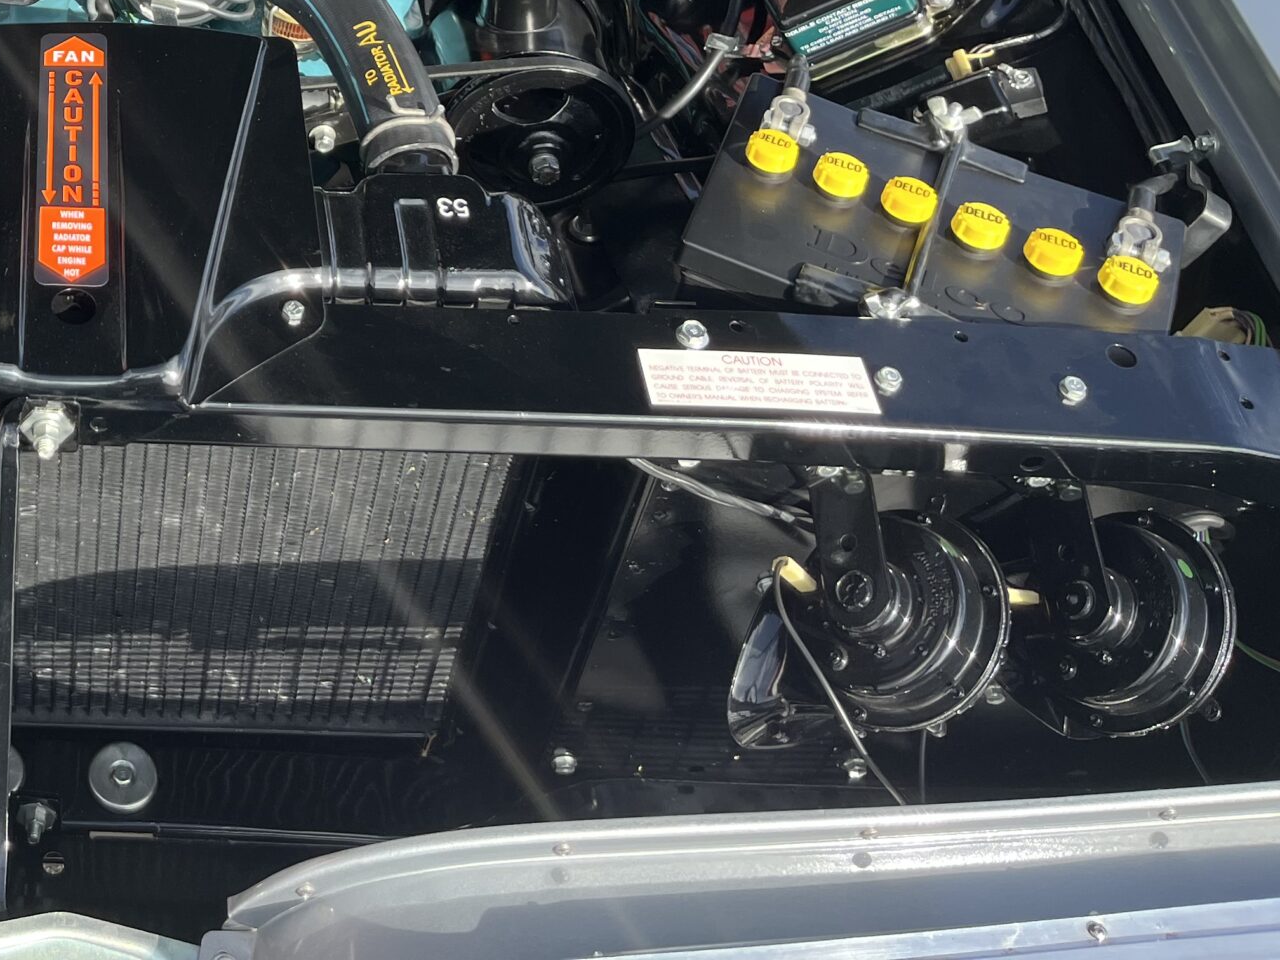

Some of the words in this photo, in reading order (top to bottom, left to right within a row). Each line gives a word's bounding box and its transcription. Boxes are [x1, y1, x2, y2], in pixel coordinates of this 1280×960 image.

[815, 5, 852, 24] CONTACT
[824, 8, 857, 25] CAUTION
[353, 21, 384, 45] AU
[52, 50, 94, 63] FAN
[365, 69, 378, 85] TO
[370, 46, 402, 94] RADIATOR
[62, 70, 83, 203] CAUTION
[758, 133, 792, 149] DELCO
[826, 156, 862, 173] DELCO
[894, 180, 931, 198] DELCO
[60, 210, 85, 219] WHEN
[436, 197, 469, 217] 53
[965, 206, 1002, 224] DELCO
[52, 221, 92, 230] REMOVING
[53, 233, 91, 242] RADIATOR
[1039, 232, 1077, 250] DELCO
[51, 244, 66, 253] CAP
[68, 244, 92, 254] WHILE
[57, 256, 86, 265] ENGINE
[64, 268, 80, 277] HOT
[1114, 260, 1152, 279] DELCO
[721, 354, 782, 366] CAUTION
